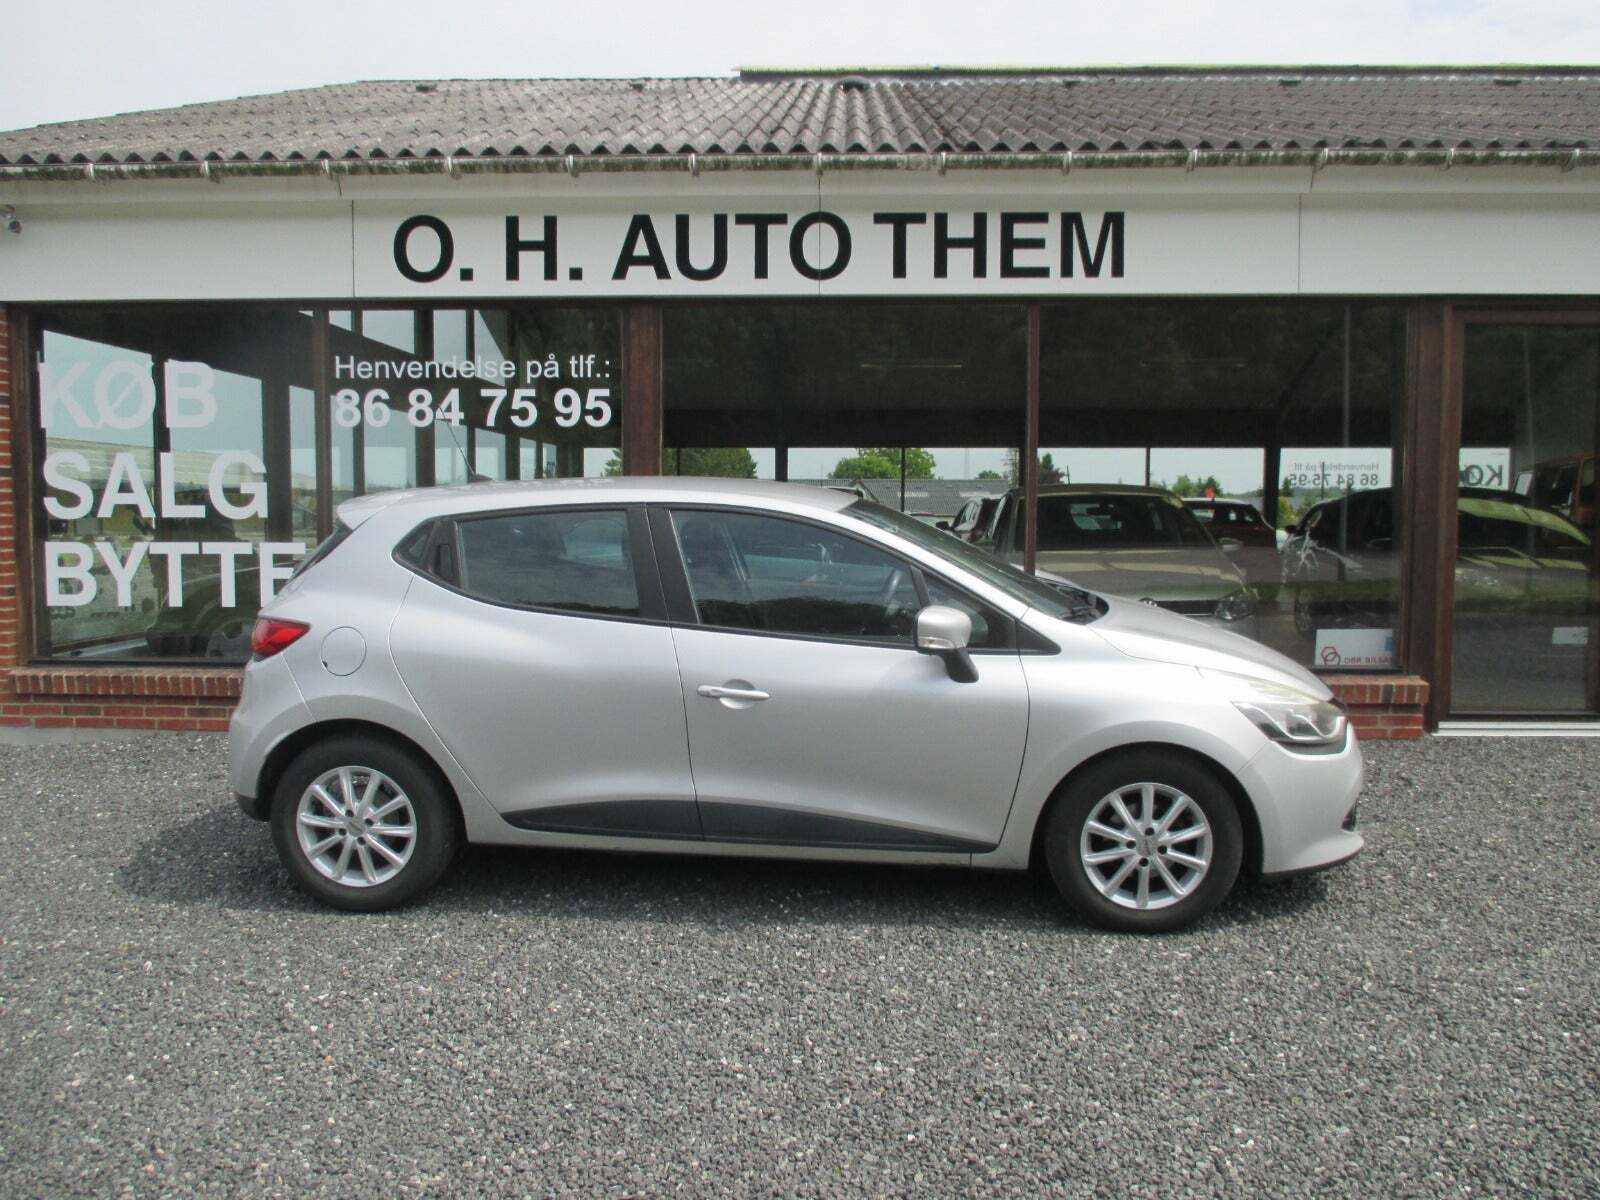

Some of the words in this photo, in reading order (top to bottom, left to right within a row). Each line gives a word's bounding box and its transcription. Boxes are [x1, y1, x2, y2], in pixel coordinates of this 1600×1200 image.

[393, 214, 474, 284] O.
[505, 215, 583, 281] H.
[611, 210, 852, 282] AUTO
[873, 211, 1125, 279] THEM
[38, 360, 217, 431] KØB
[335, 355, 516, 380] Henvendelse
[526, 353, 560, 384] på
[569, 354, 611, 379] tlf.:
[335, 388, 391, 428] 86
[407, 388, 465, 428] 84
[480, 388, 538, 428] 75
[553, 387, 612, 428] 95
[43, 451, 269, 521] SALG
